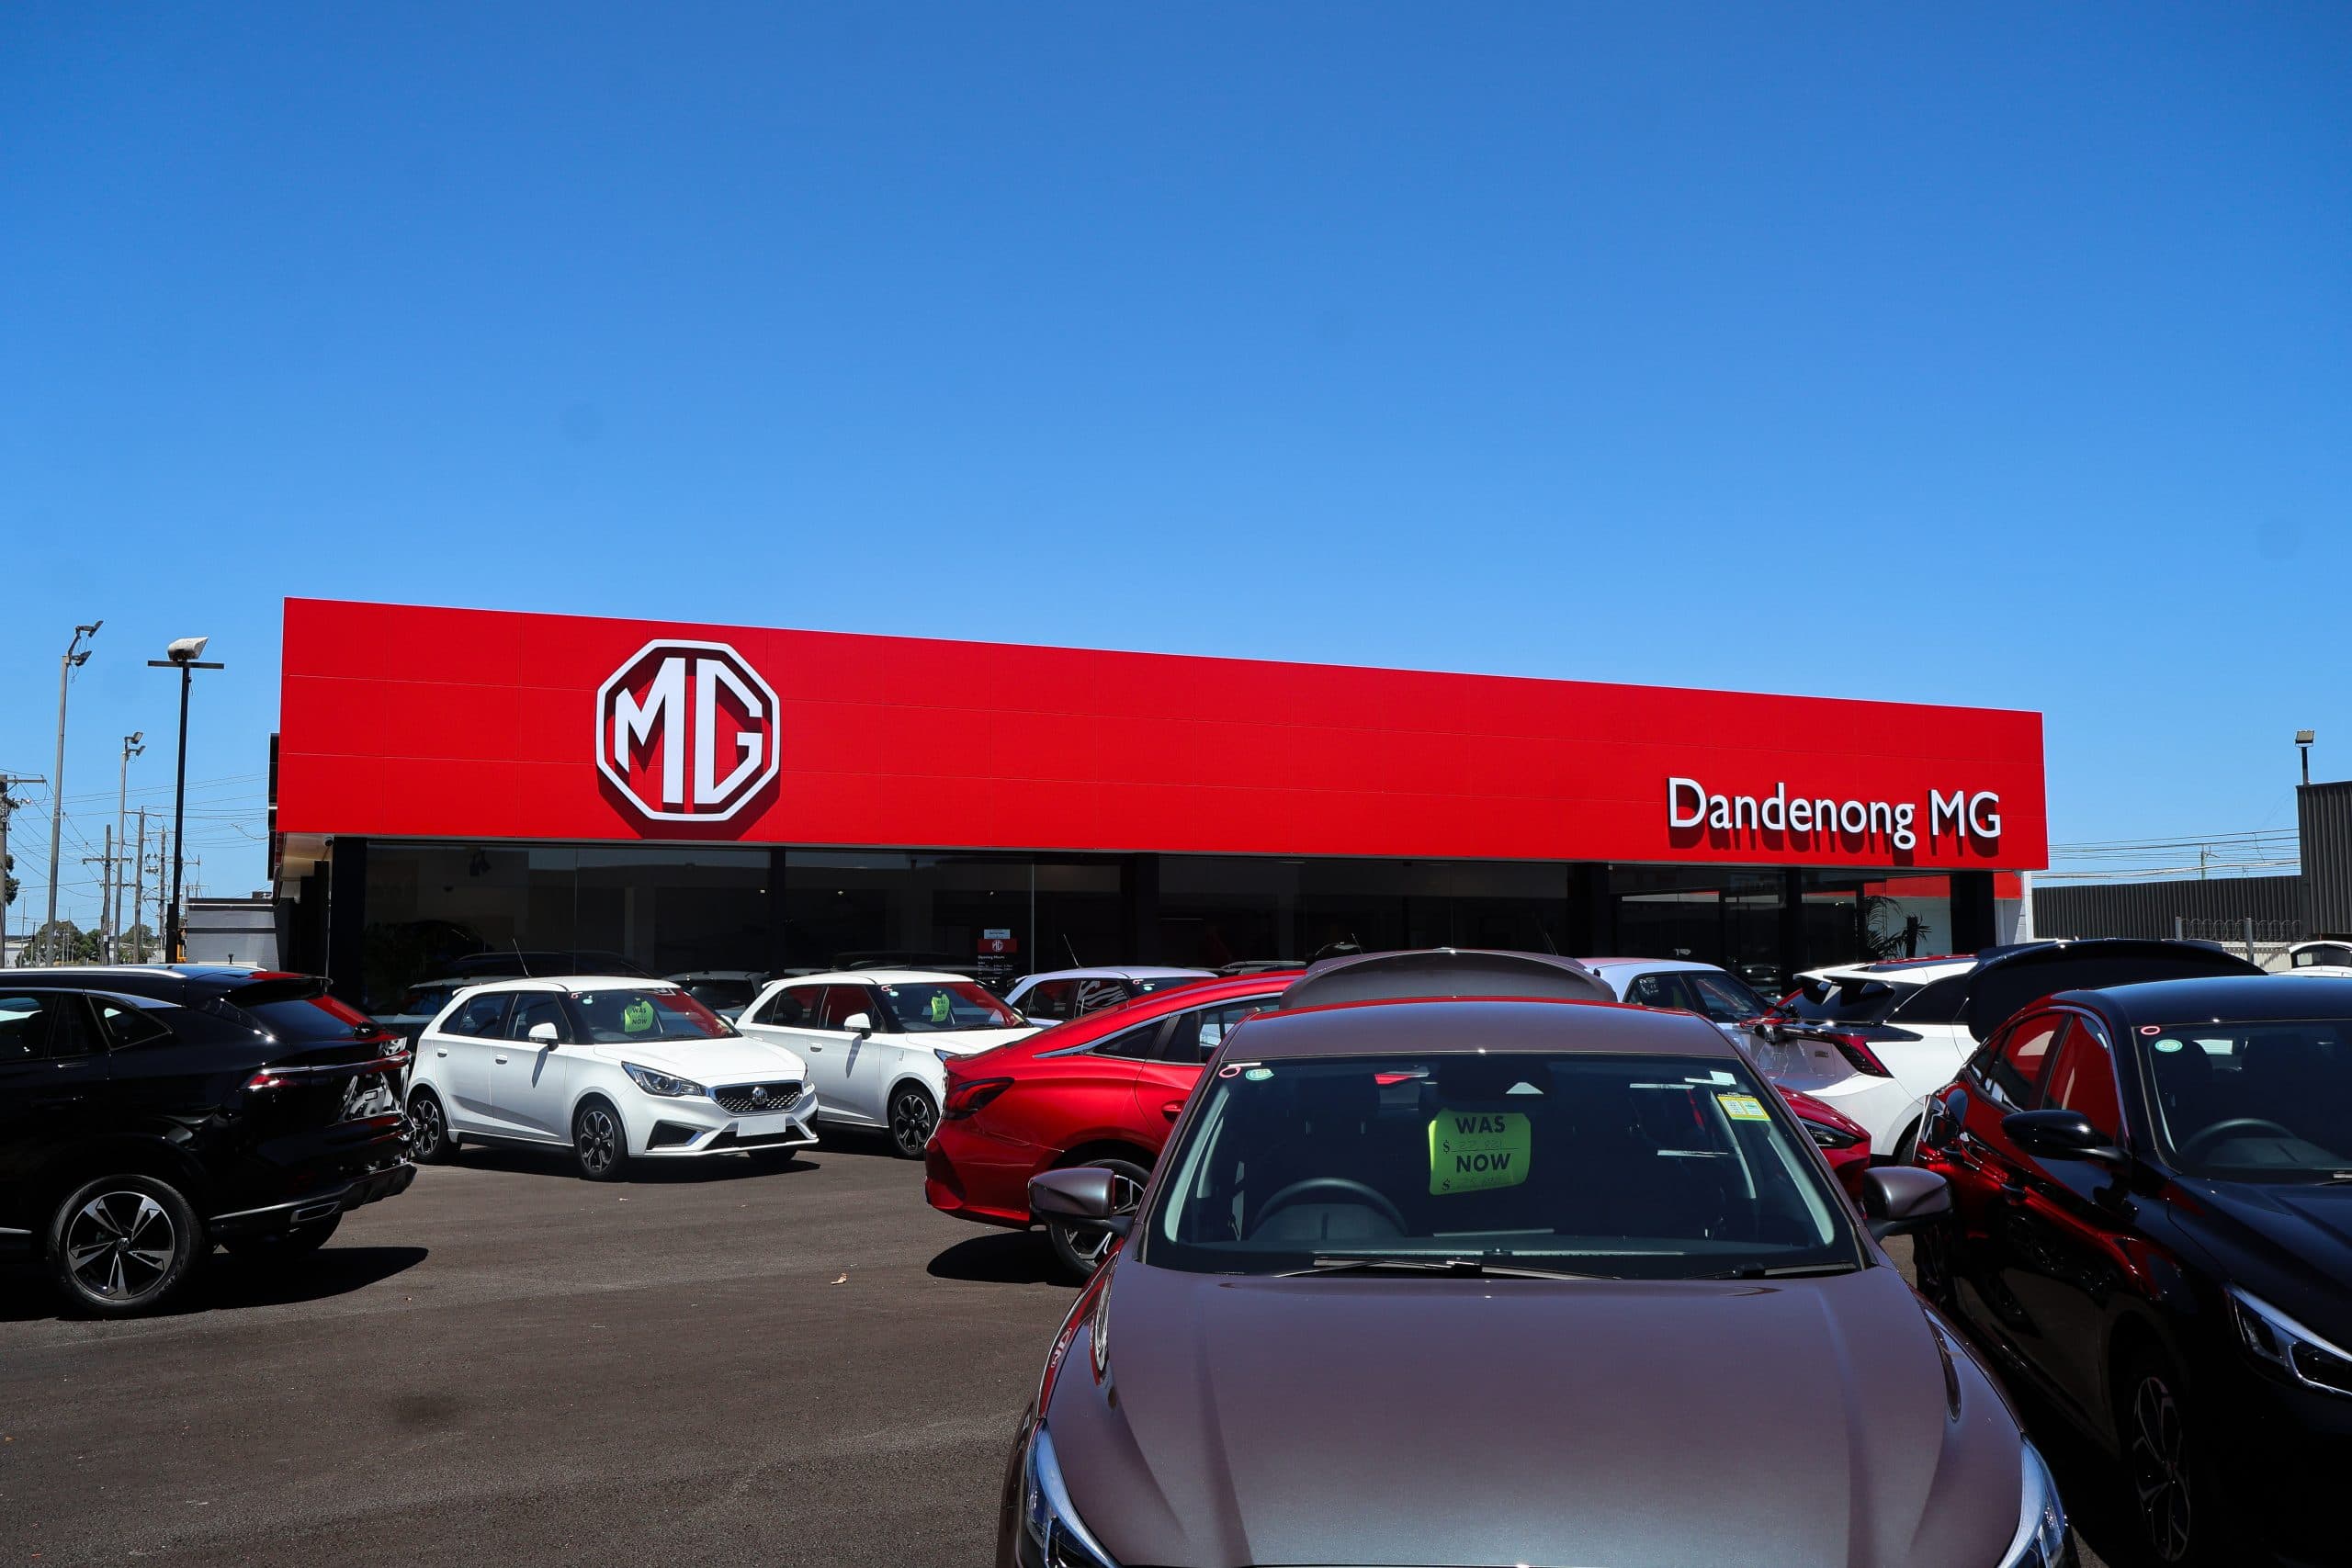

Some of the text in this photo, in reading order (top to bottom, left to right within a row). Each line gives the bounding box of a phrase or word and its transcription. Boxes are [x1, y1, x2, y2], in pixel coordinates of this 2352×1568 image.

[615, 657, 763, 804] MG
[1668, 777, 2002, 850] Dandenong MG
[1454, 1115, 1506, 1134] WAS
[1455, 1153, 1511, 1173] NOW
